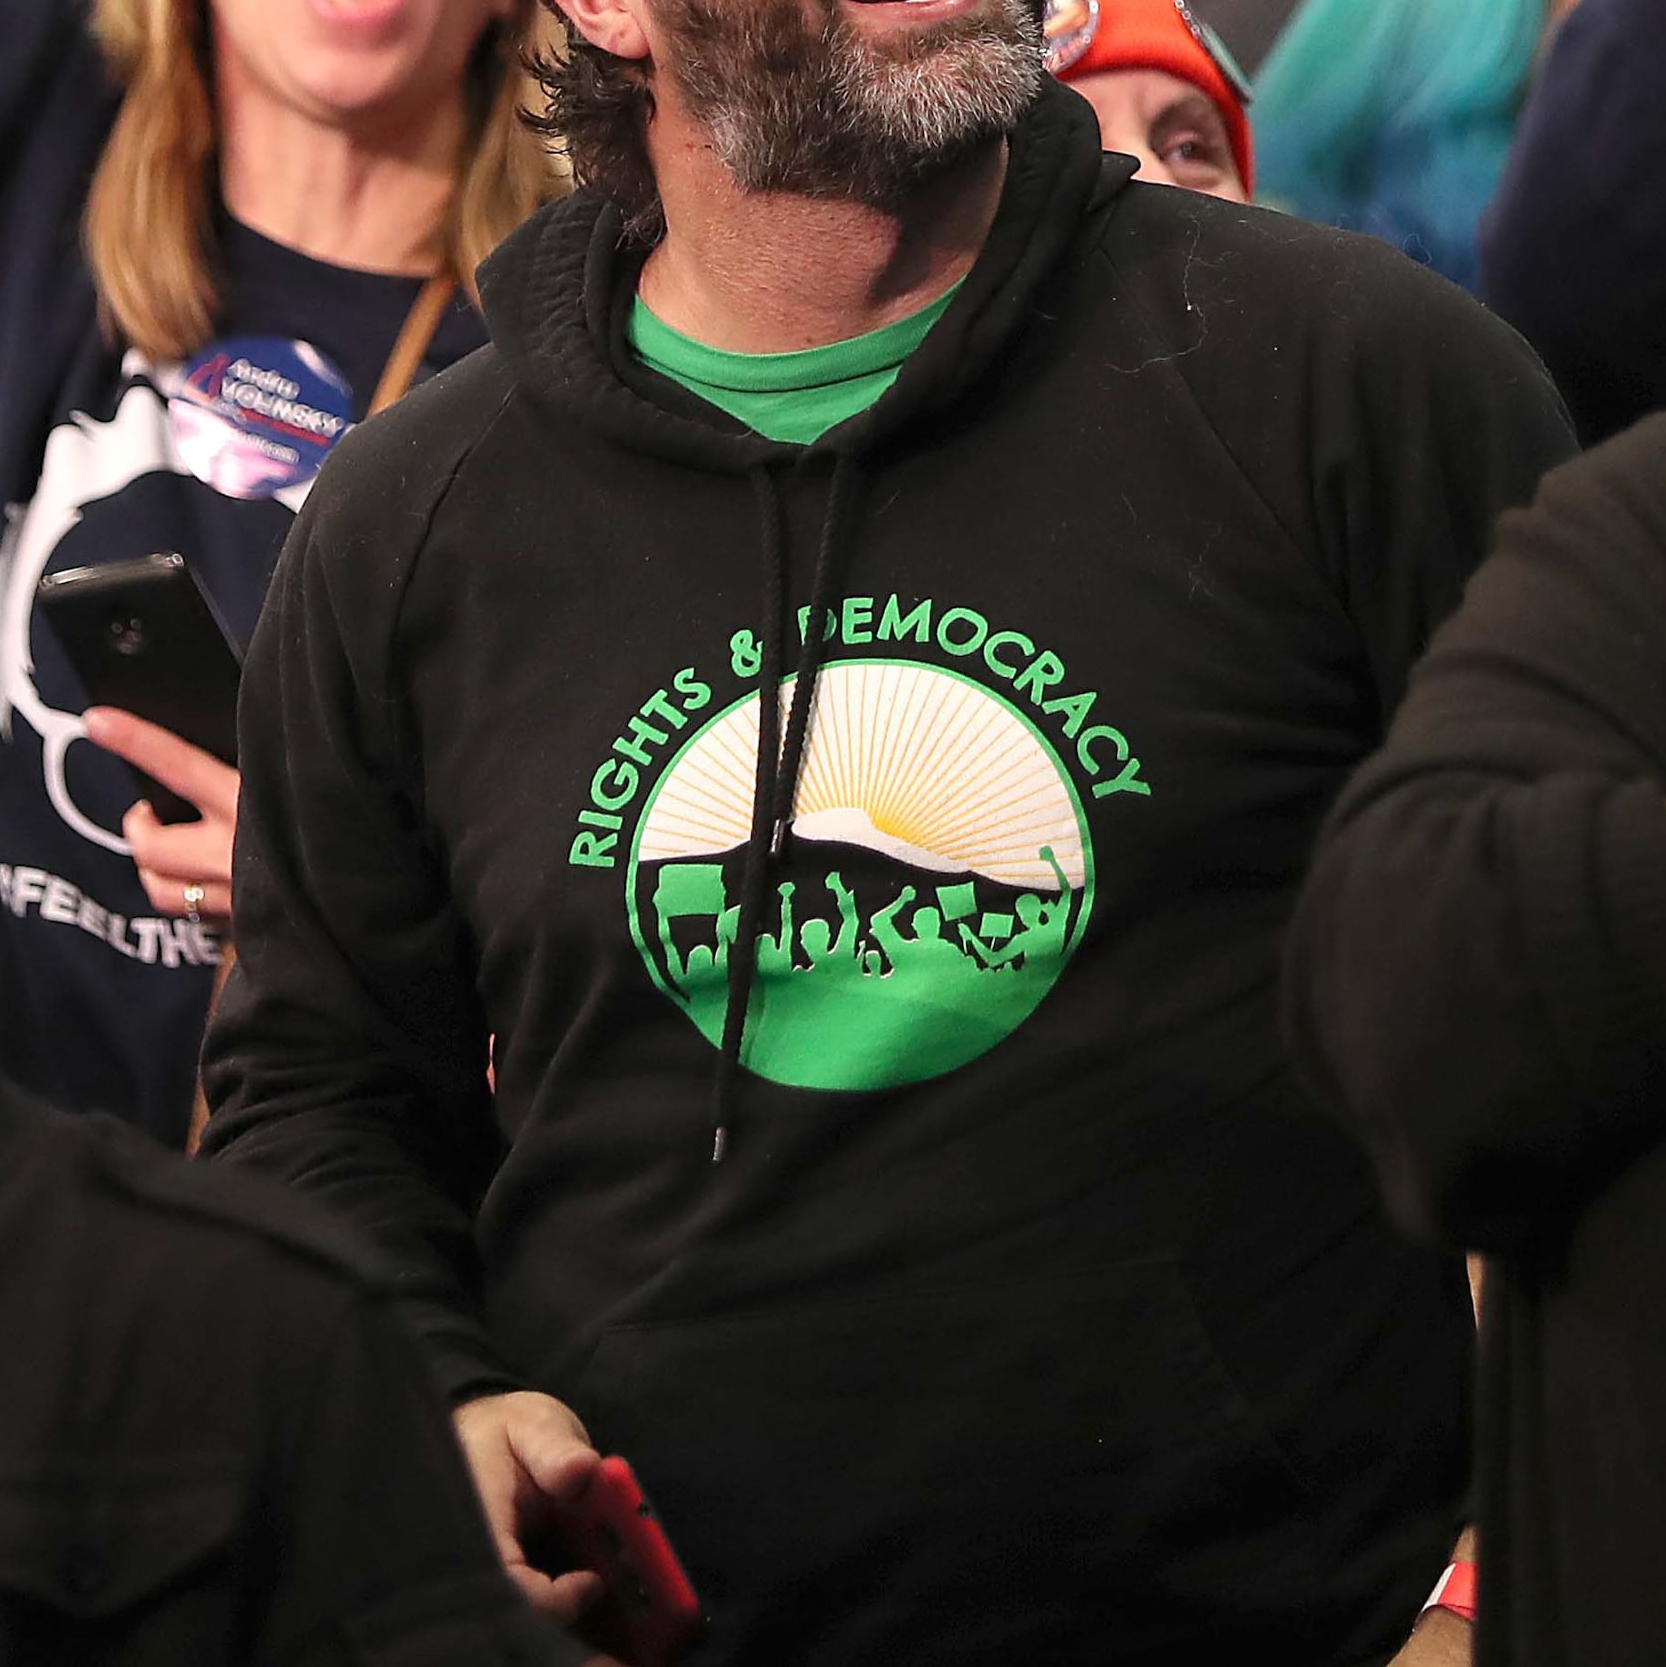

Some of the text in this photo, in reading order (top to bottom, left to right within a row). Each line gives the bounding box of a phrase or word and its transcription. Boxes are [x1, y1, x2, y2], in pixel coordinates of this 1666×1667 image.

[568, 592, 1152, 869] RIGHTS & DEMOCRACY
